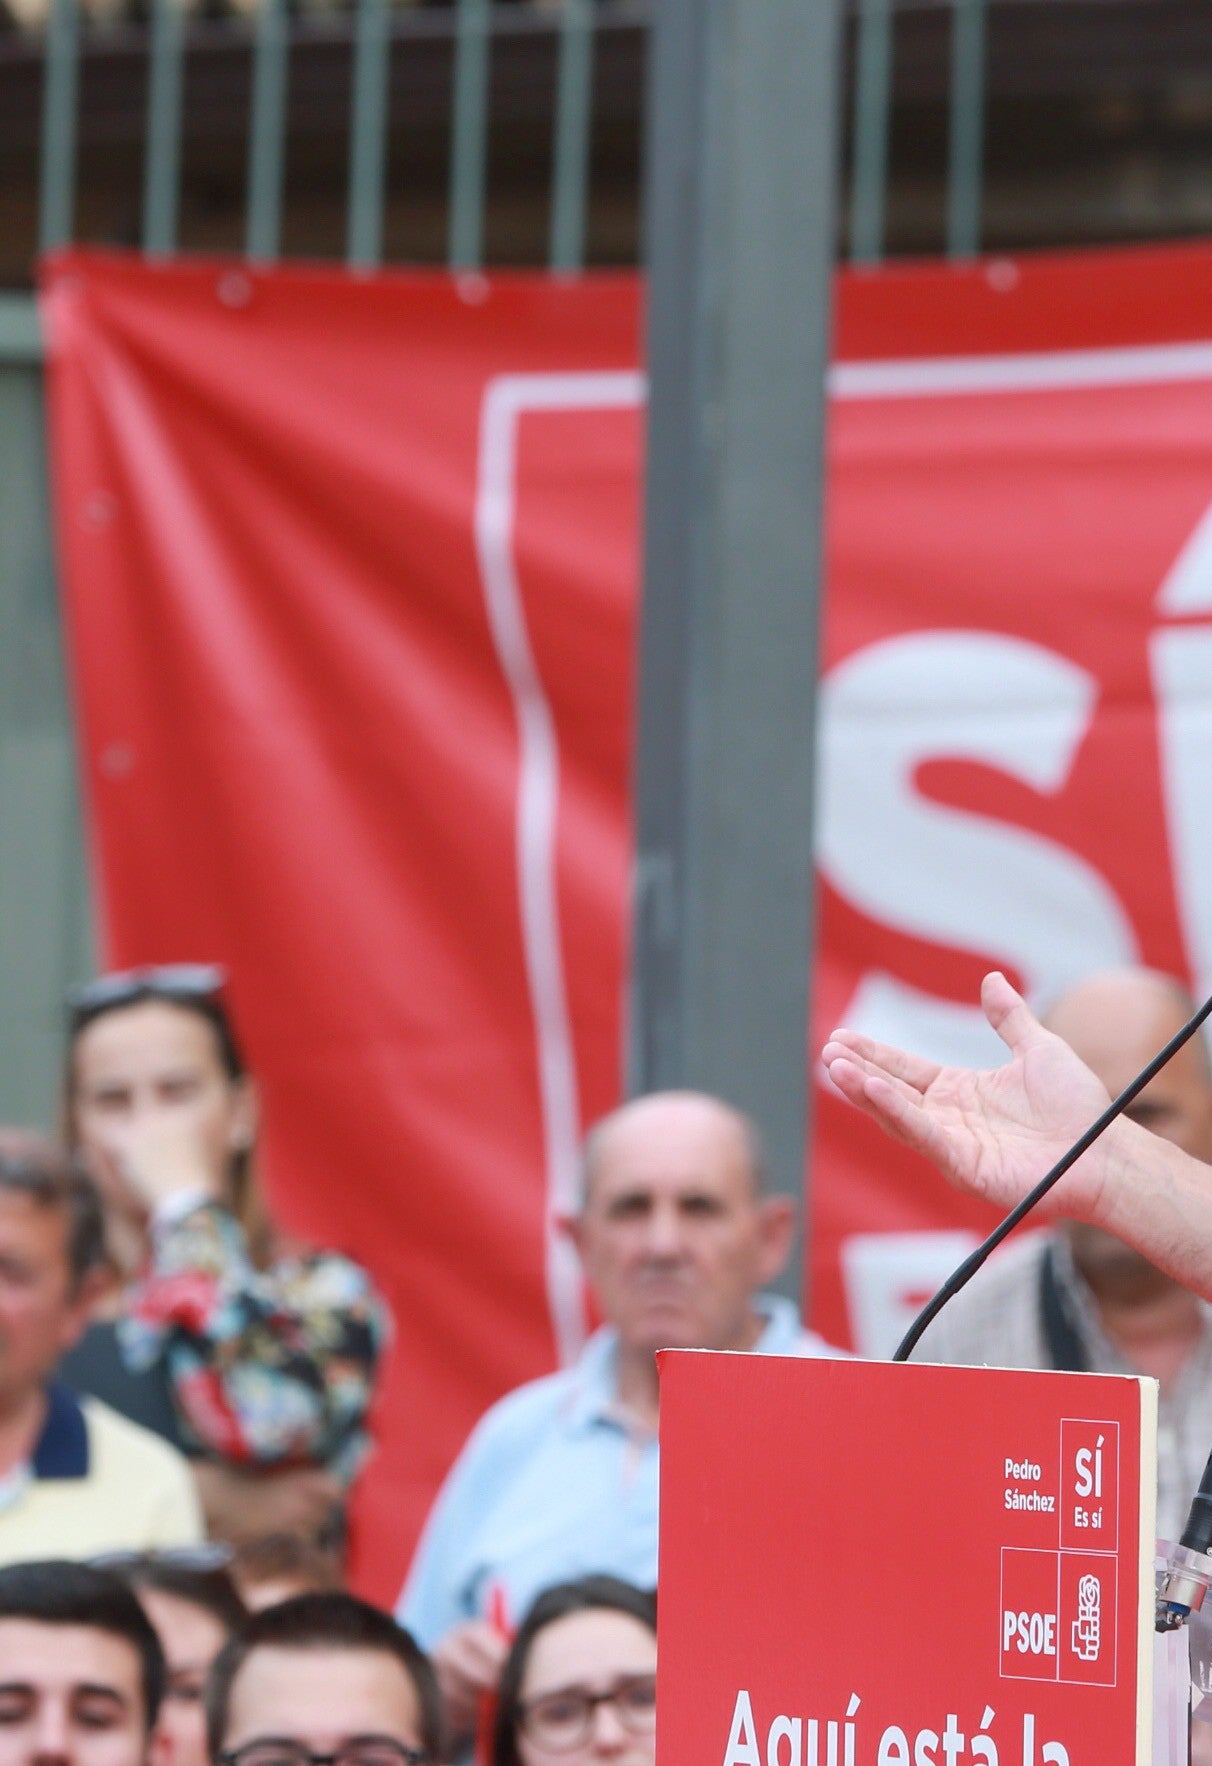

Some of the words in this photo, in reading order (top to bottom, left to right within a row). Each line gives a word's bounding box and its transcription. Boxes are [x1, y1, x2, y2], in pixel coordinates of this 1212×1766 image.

[1004, 1458, 1042, 1481] Pedro
[1075, 1434, 1105, 1498] SÍ
[1004, 1488, 1055, 1512] Sánchez
[1074, 1506, 1089, 1528] Es
[1091, 1506, 1103, 1529] sí
[1003, 1610, 1057, 1656] PSOE
[722, 1690, 862, 1766] Aquí
